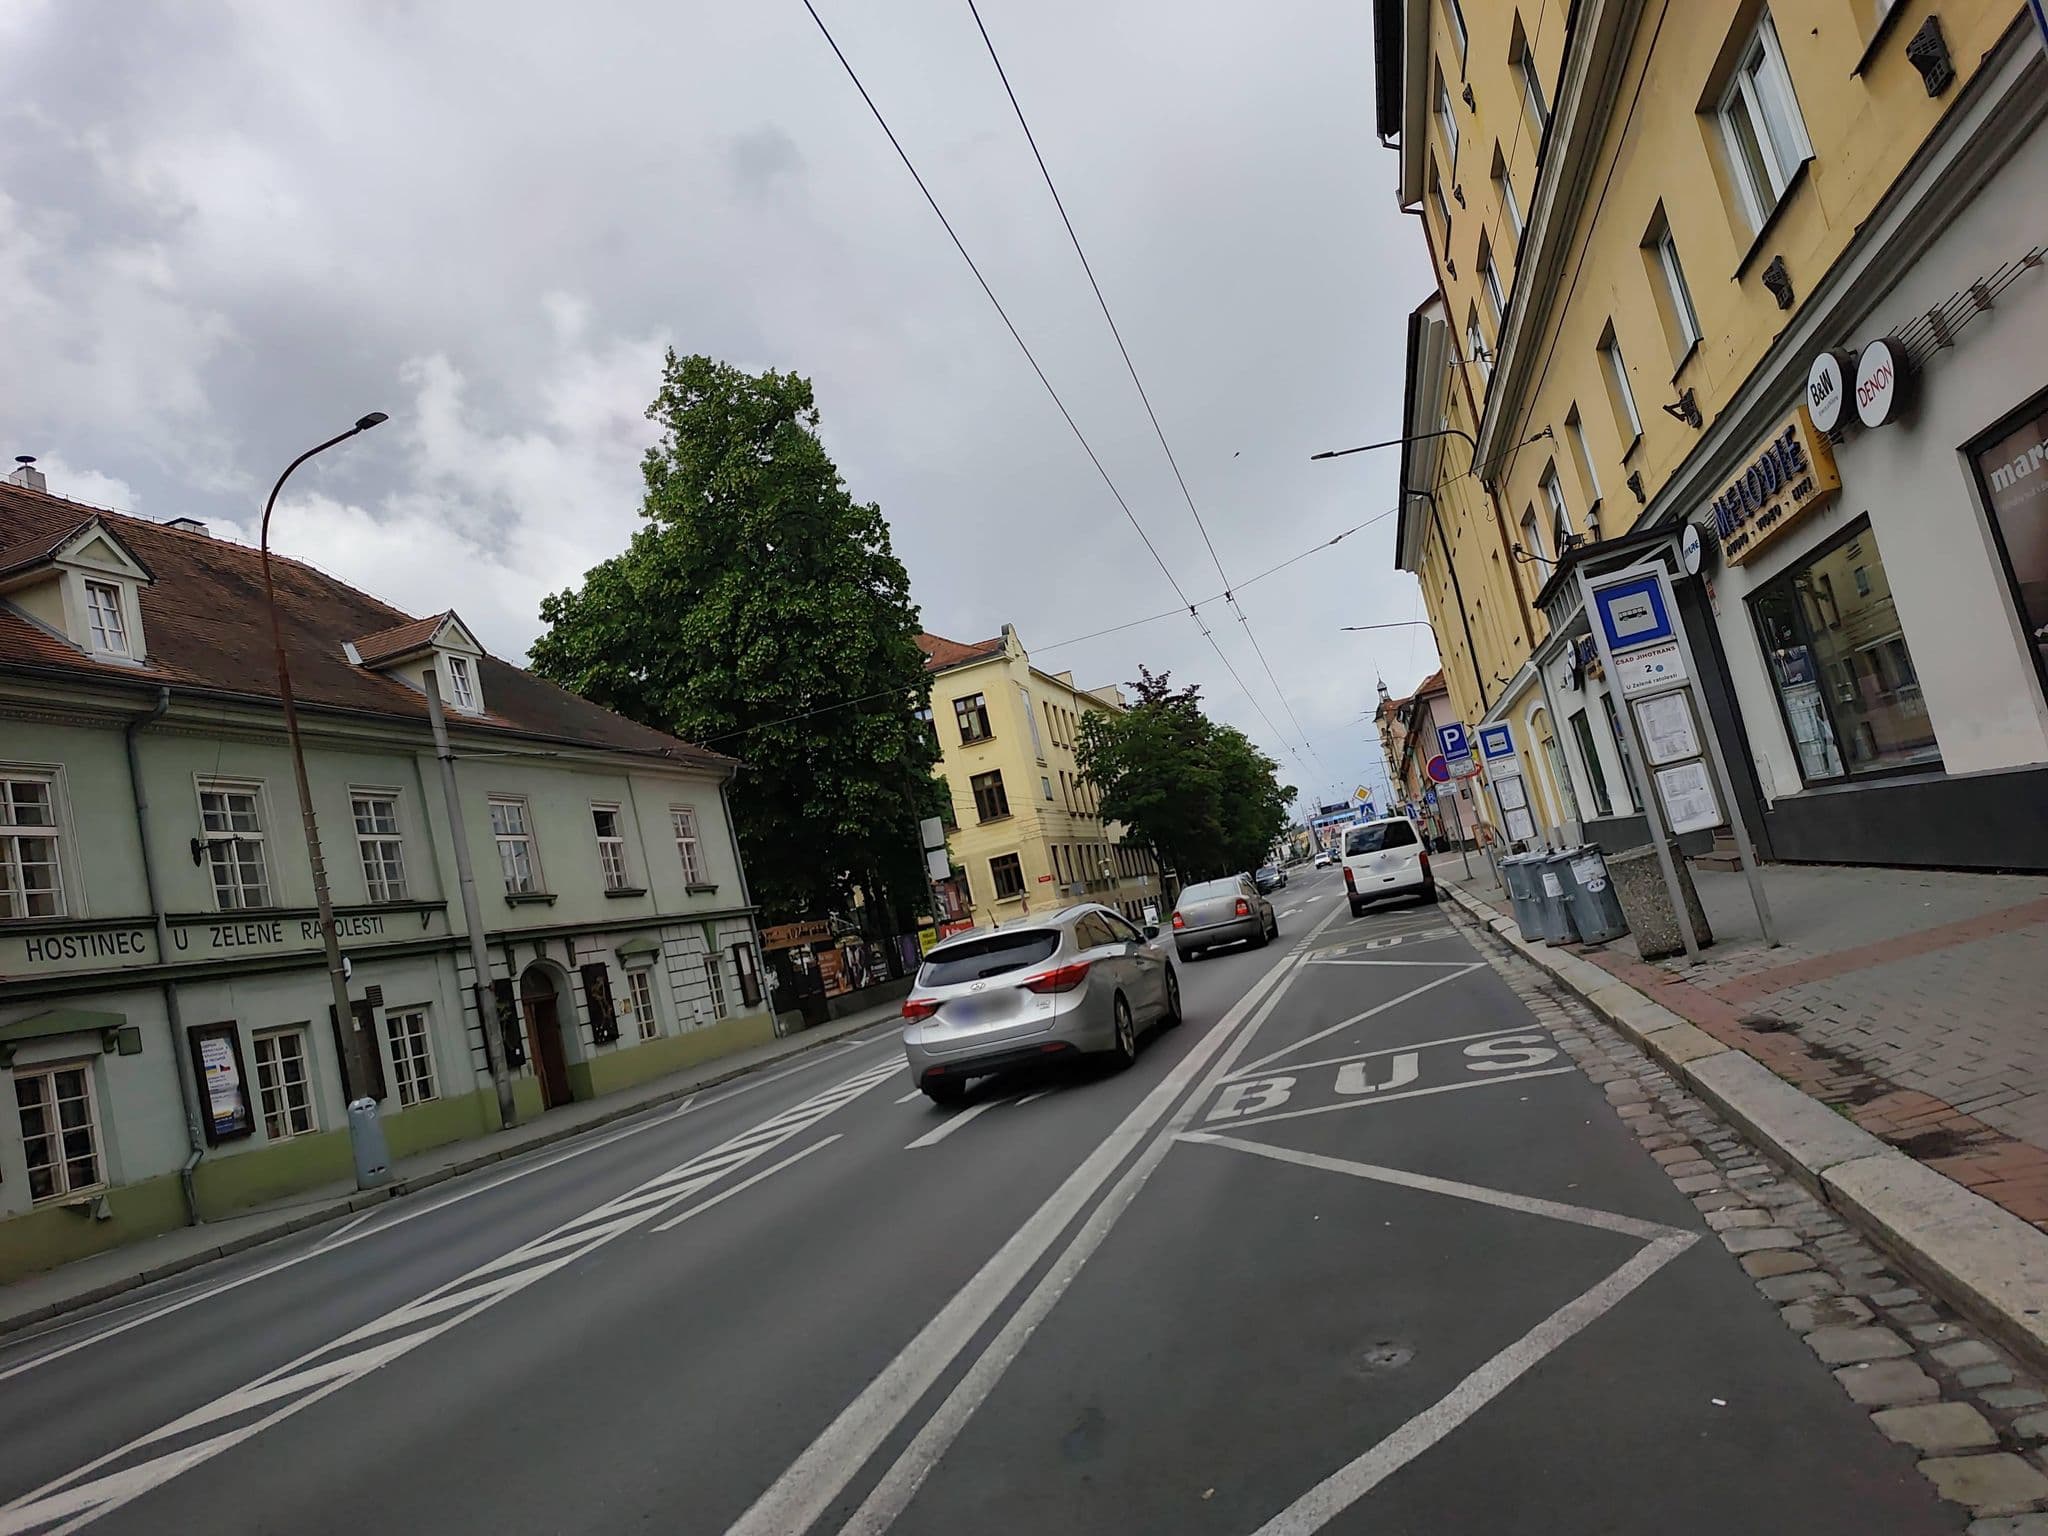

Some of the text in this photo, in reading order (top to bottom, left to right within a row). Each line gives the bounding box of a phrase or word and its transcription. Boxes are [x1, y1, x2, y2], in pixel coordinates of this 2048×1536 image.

[1810, 368, 1834, 407] B&W
[1857, 360, 1893, 408] DENON
[1712, 424, 1808, 540] MELODIE
[1756, 504, 1782, 531] VIDEO
[1636, 646, 1676, 661] JIHOTRANS
[1645, 664, 1653, 673] 2
[1443, 728, 1460, 751] P
[26, 931, 146, 962] HOSTINEC
[173, 928, 189, 951] U
[301, 916, 385, 940] RAOLESTI
[1204, 1035, 1559, 1122] BUS
